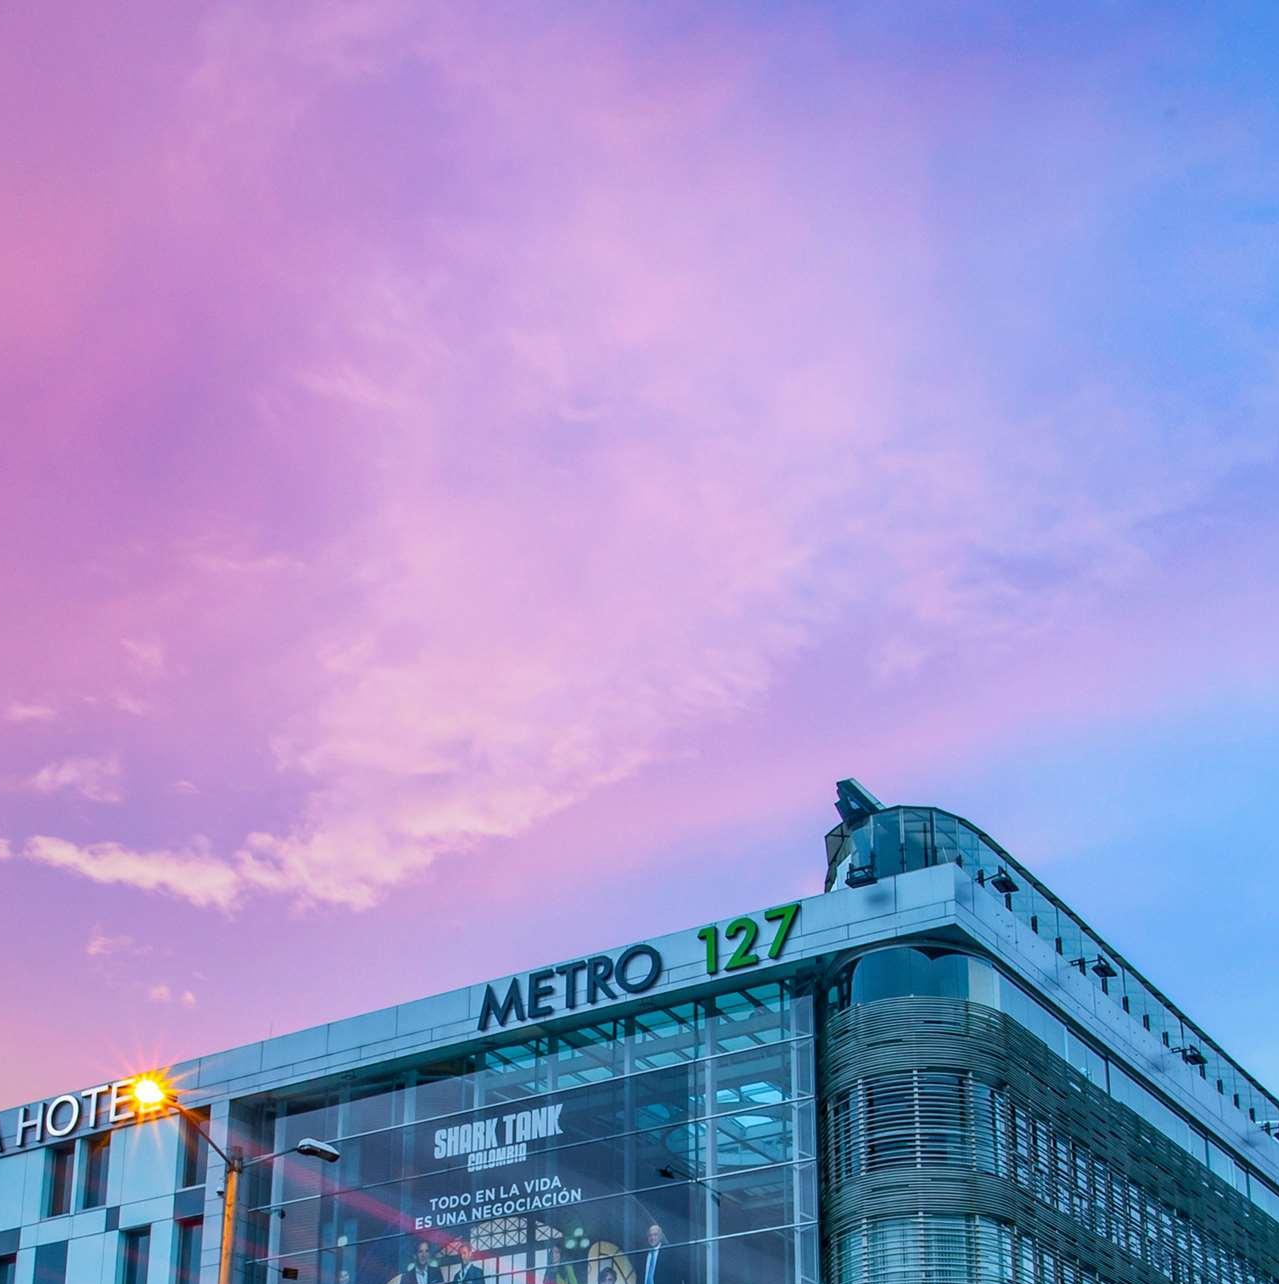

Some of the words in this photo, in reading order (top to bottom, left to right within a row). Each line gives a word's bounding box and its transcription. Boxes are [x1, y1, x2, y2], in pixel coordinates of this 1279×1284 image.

[477, 944, 662, 1031] METRO
[697, 903, 801, 976] 127
[434, 1118, 499, 1159] SHARK
[503, 1104, 564, 1145] TANK
[467, 1143, 527, 1172] COLOMBIA
[415, 1217, 432, 1230] ES
[437, 1211, 468, 1226] UNA
[472, 1188, 582, 1220] NEGOCIACIÓN
[430, 1193, 471, 1211] TODO
[476, 1188, 495, 1203] EN
[500, 1184, 520, 1199] LA
[524, 1176, 562, 1192] VIDA
